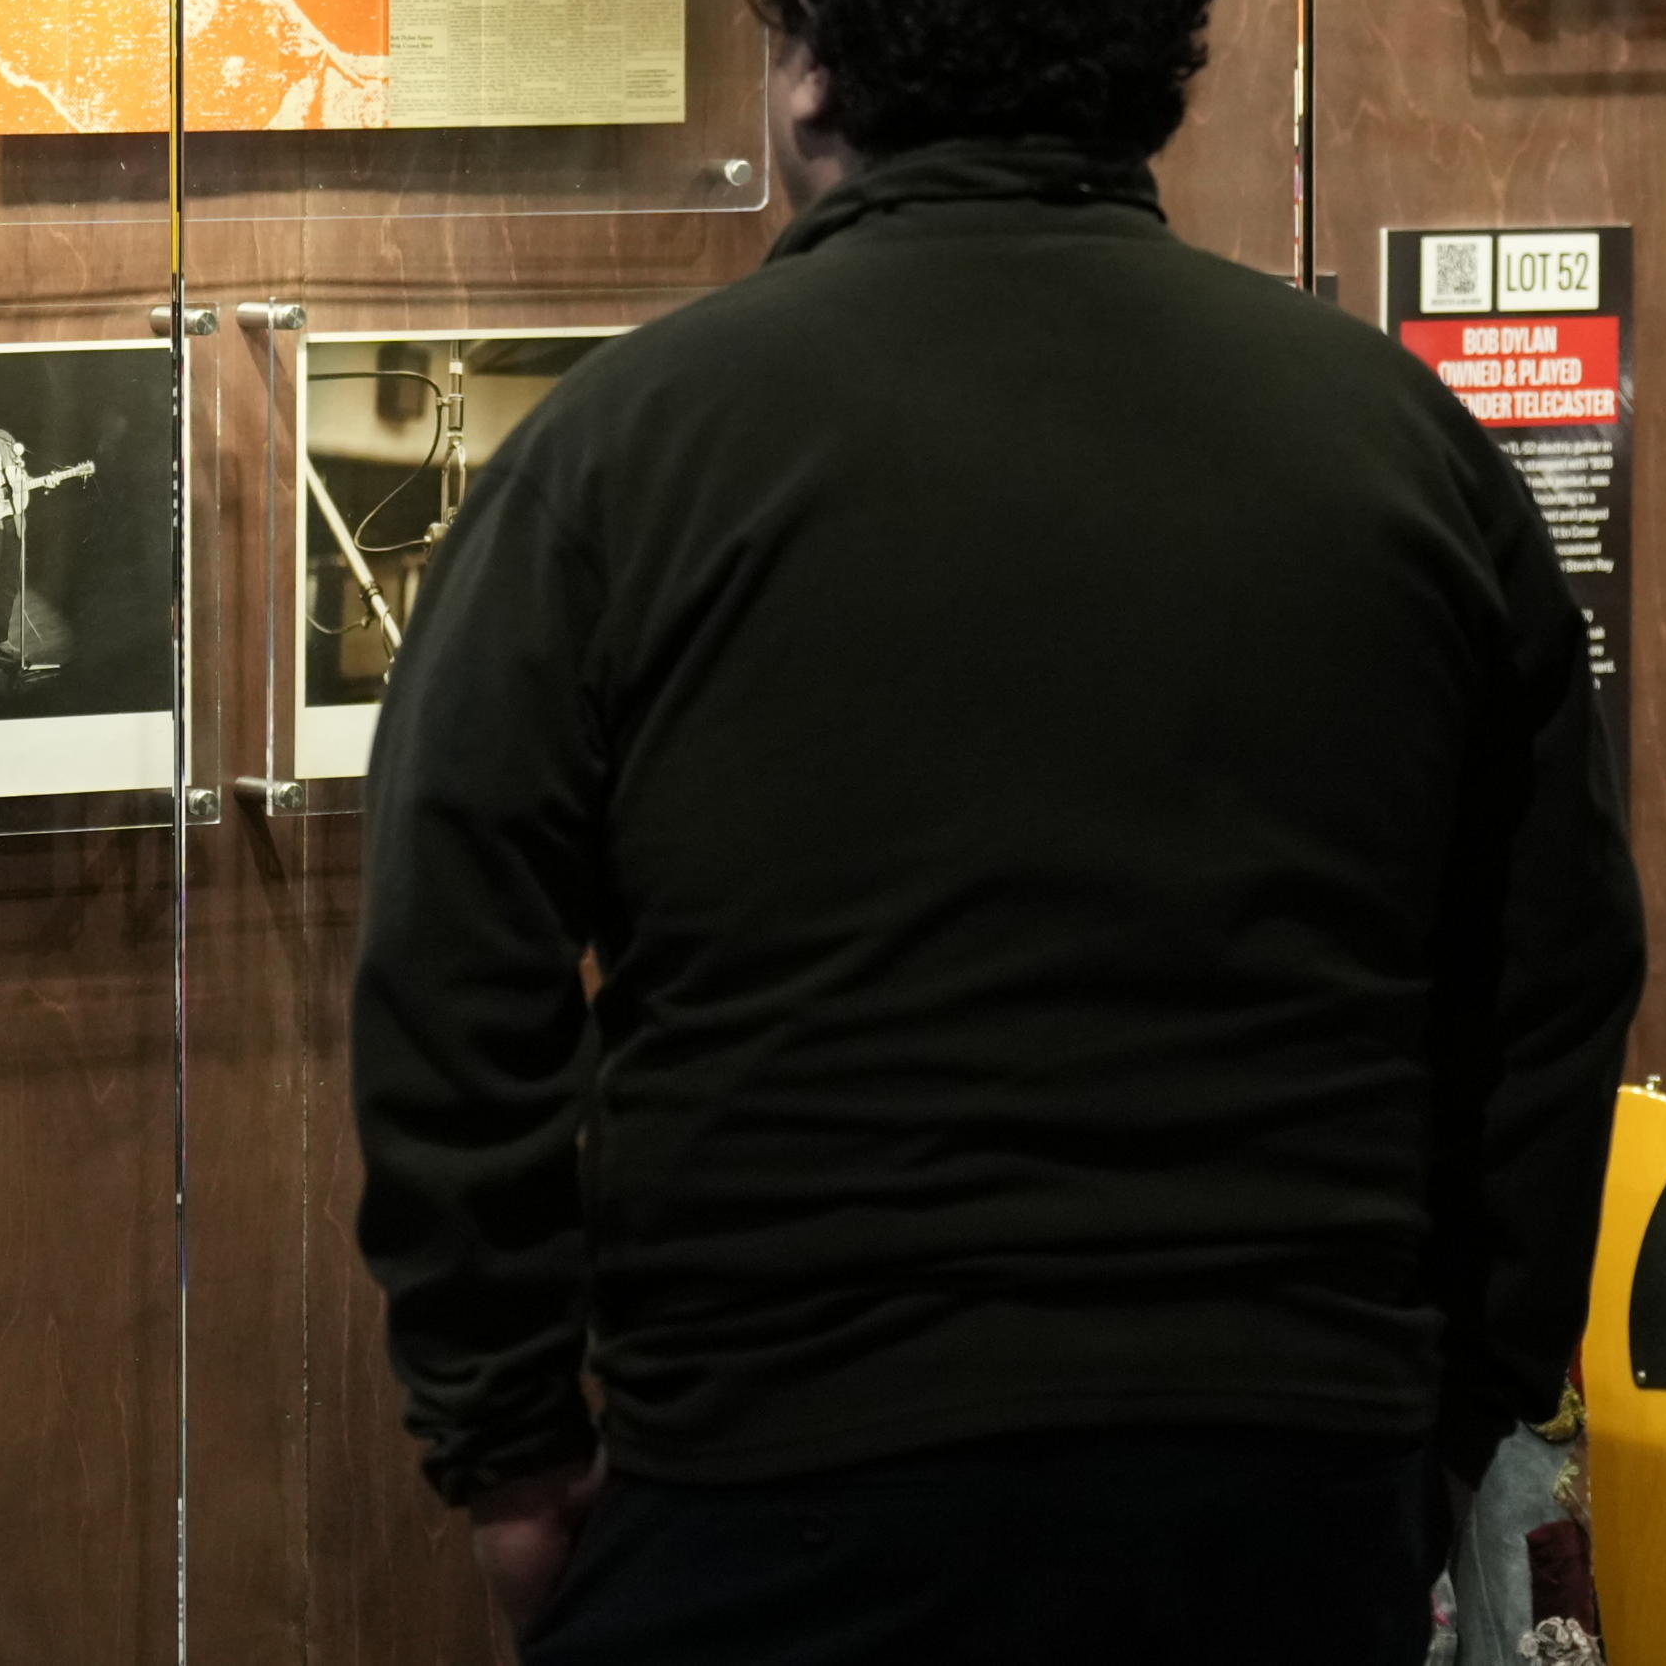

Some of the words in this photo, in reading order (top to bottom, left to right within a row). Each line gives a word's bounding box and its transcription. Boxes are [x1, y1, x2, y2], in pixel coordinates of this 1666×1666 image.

[1506, 252, 1551, 292] LOT
[1558, 252, 1589, 291] 52
[1462, 327, 1499, 356] BOB
[1500, 325, 1557, 355] DYLAN
[1438, 359, 1502, 388] OWNED
[1503, 358, 1517, 387] &
[1518, 357, 1582, 386] PLAYED
[1514, 389, 1615, 419] TELECASTER
